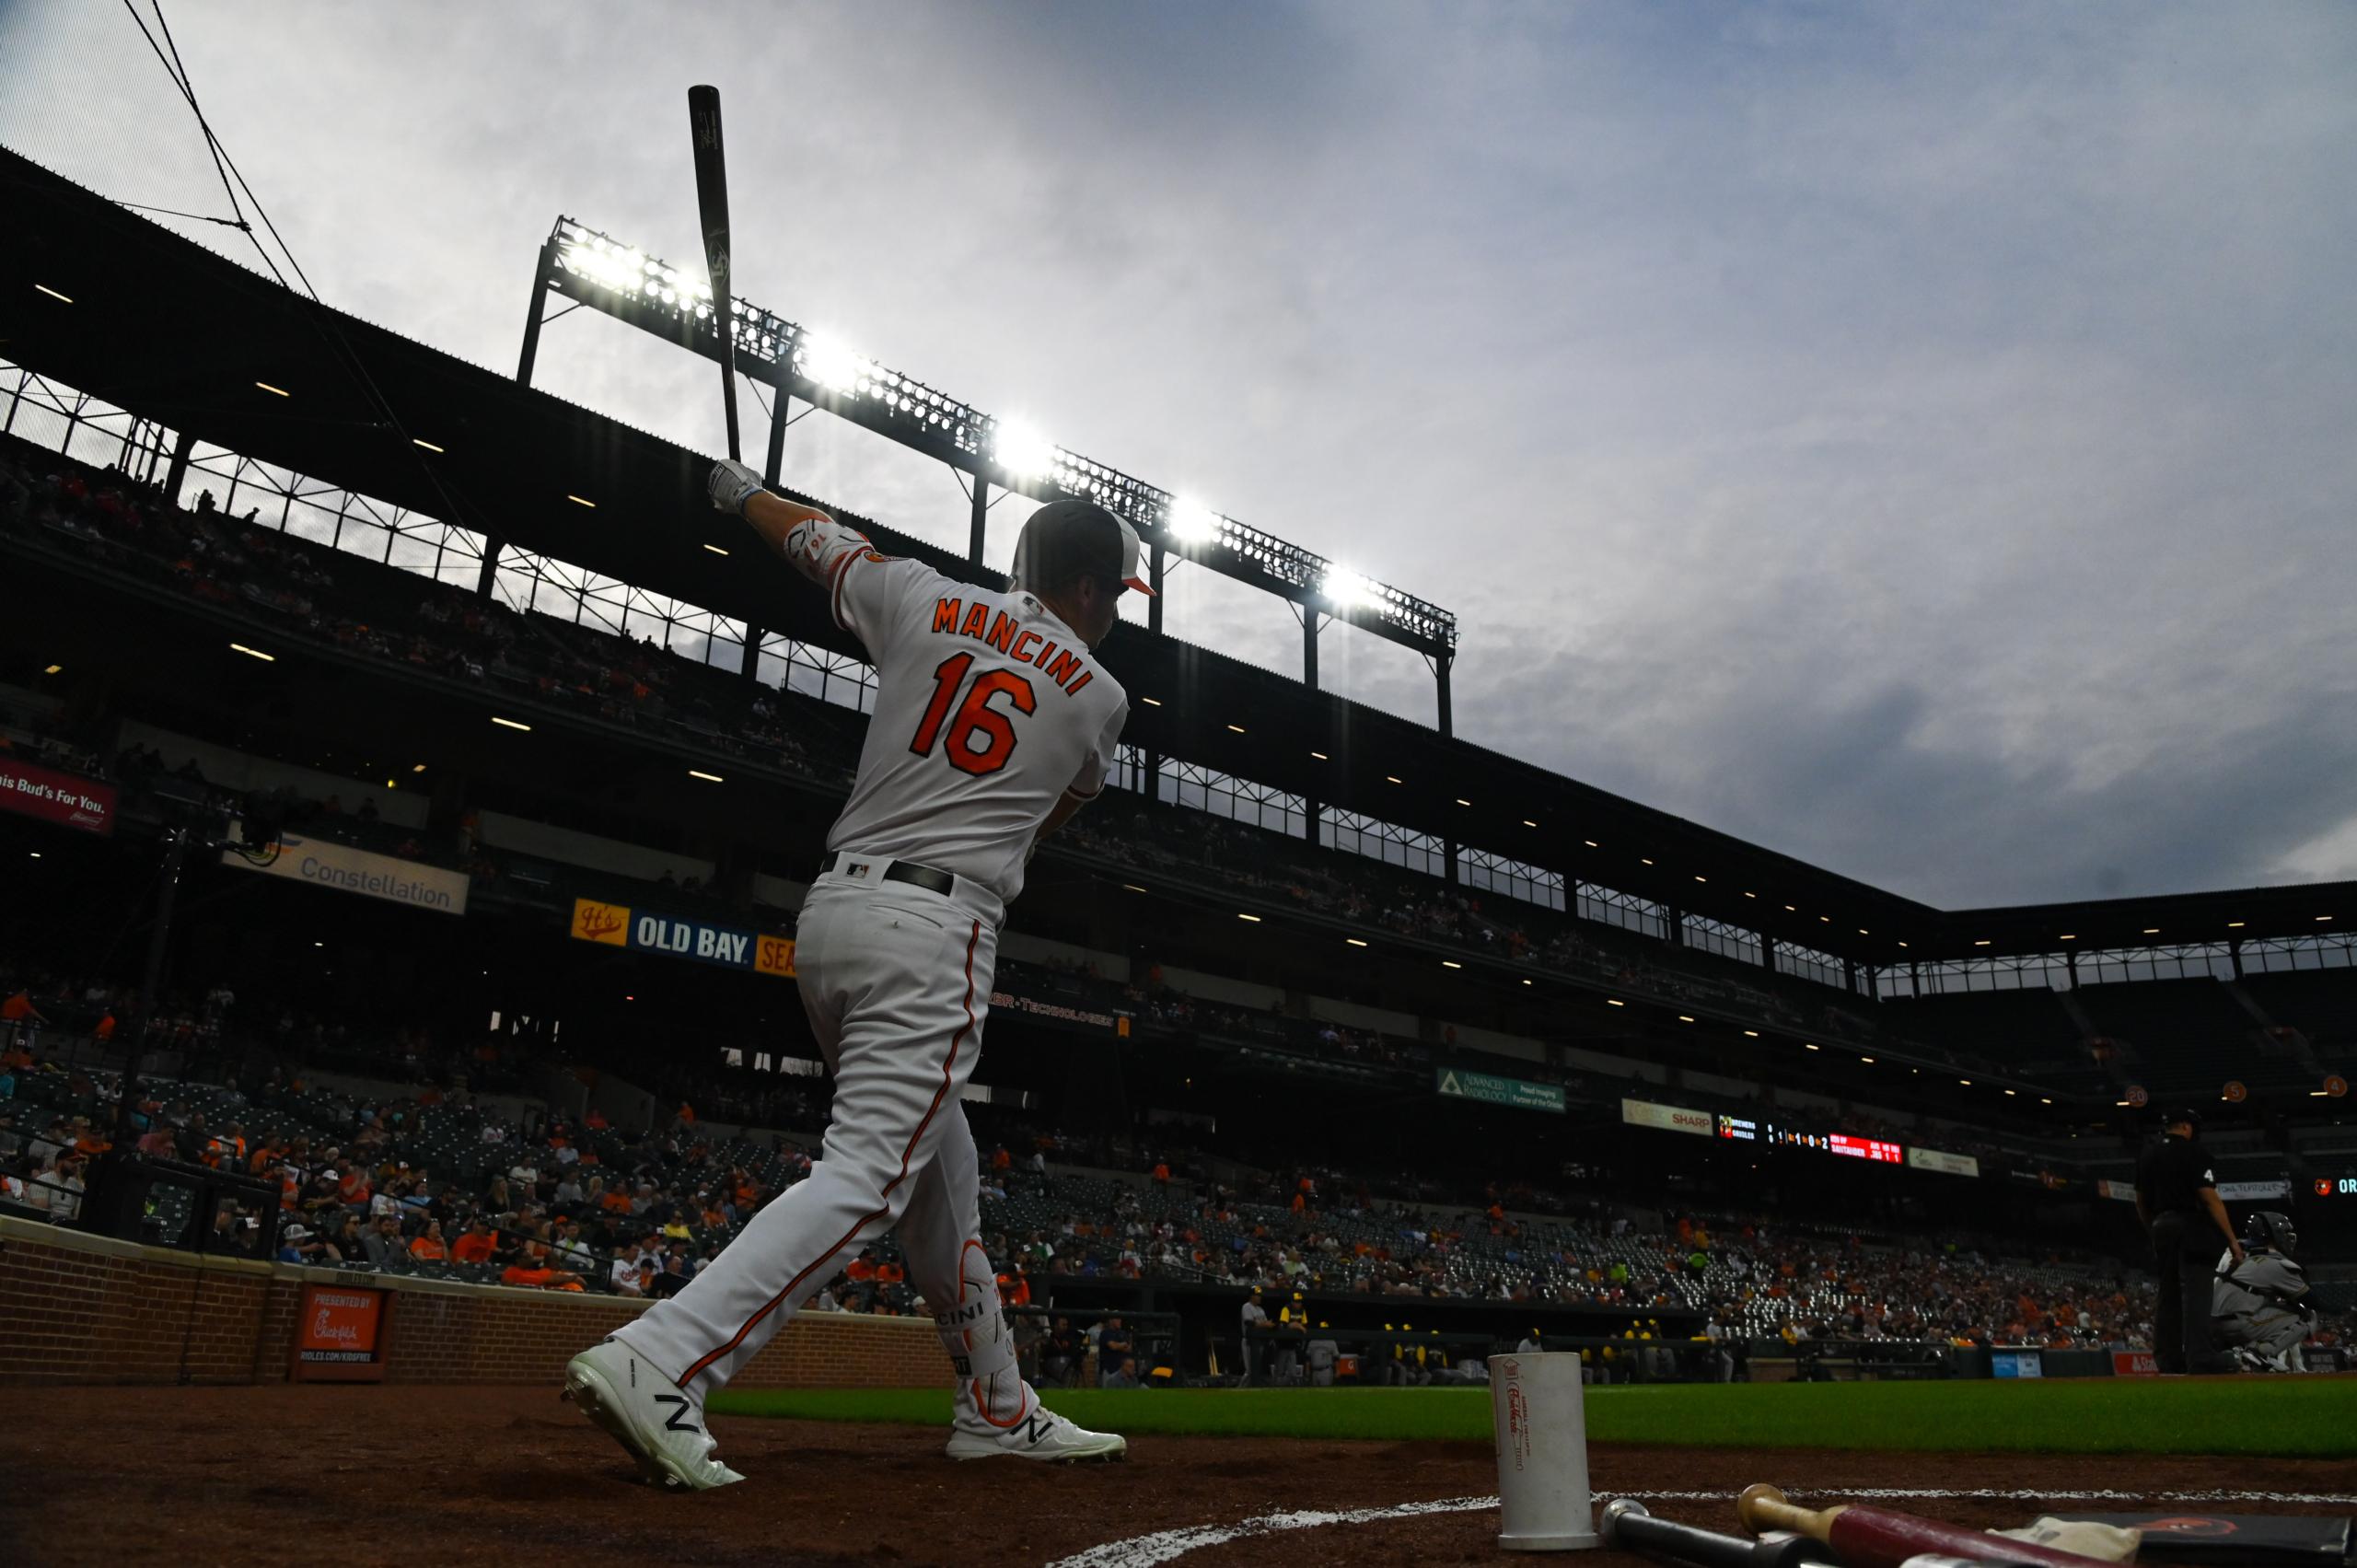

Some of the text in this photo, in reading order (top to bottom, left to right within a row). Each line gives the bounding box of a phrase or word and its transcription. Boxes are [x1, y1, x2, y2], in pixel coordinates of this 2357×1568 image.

[932, 598, 1094, 697] MANCINI
[909, 651, 1038, 777] 16
[0, 774, 106, 815] is Bud's For You.
[300, 856, 450, 908] Constellation
[582, 906, 617, 934] It's
[637, 916, 691, 953] OLD
[696, 927, 749, 964] BAY
[1464, 1072, 1504, 1091] ADVANCED
[2330, 1081, 2340, 1091] 4
[1464, 1085, 1507, 1102] RADIOLOGY
[2128, 1090, 2143, 1102] 20
[2231, 1086, 2240, 1098] 5
[1672, 1113, 1710, 1128] SHARP
[1821, 1136, 1829, 1150] 2
[2203, 1168, 2214, 1182] 4
[2339, 1179, 2357, 1194] OR
[315, 1294, 372, 1309] PRESENTED BY
